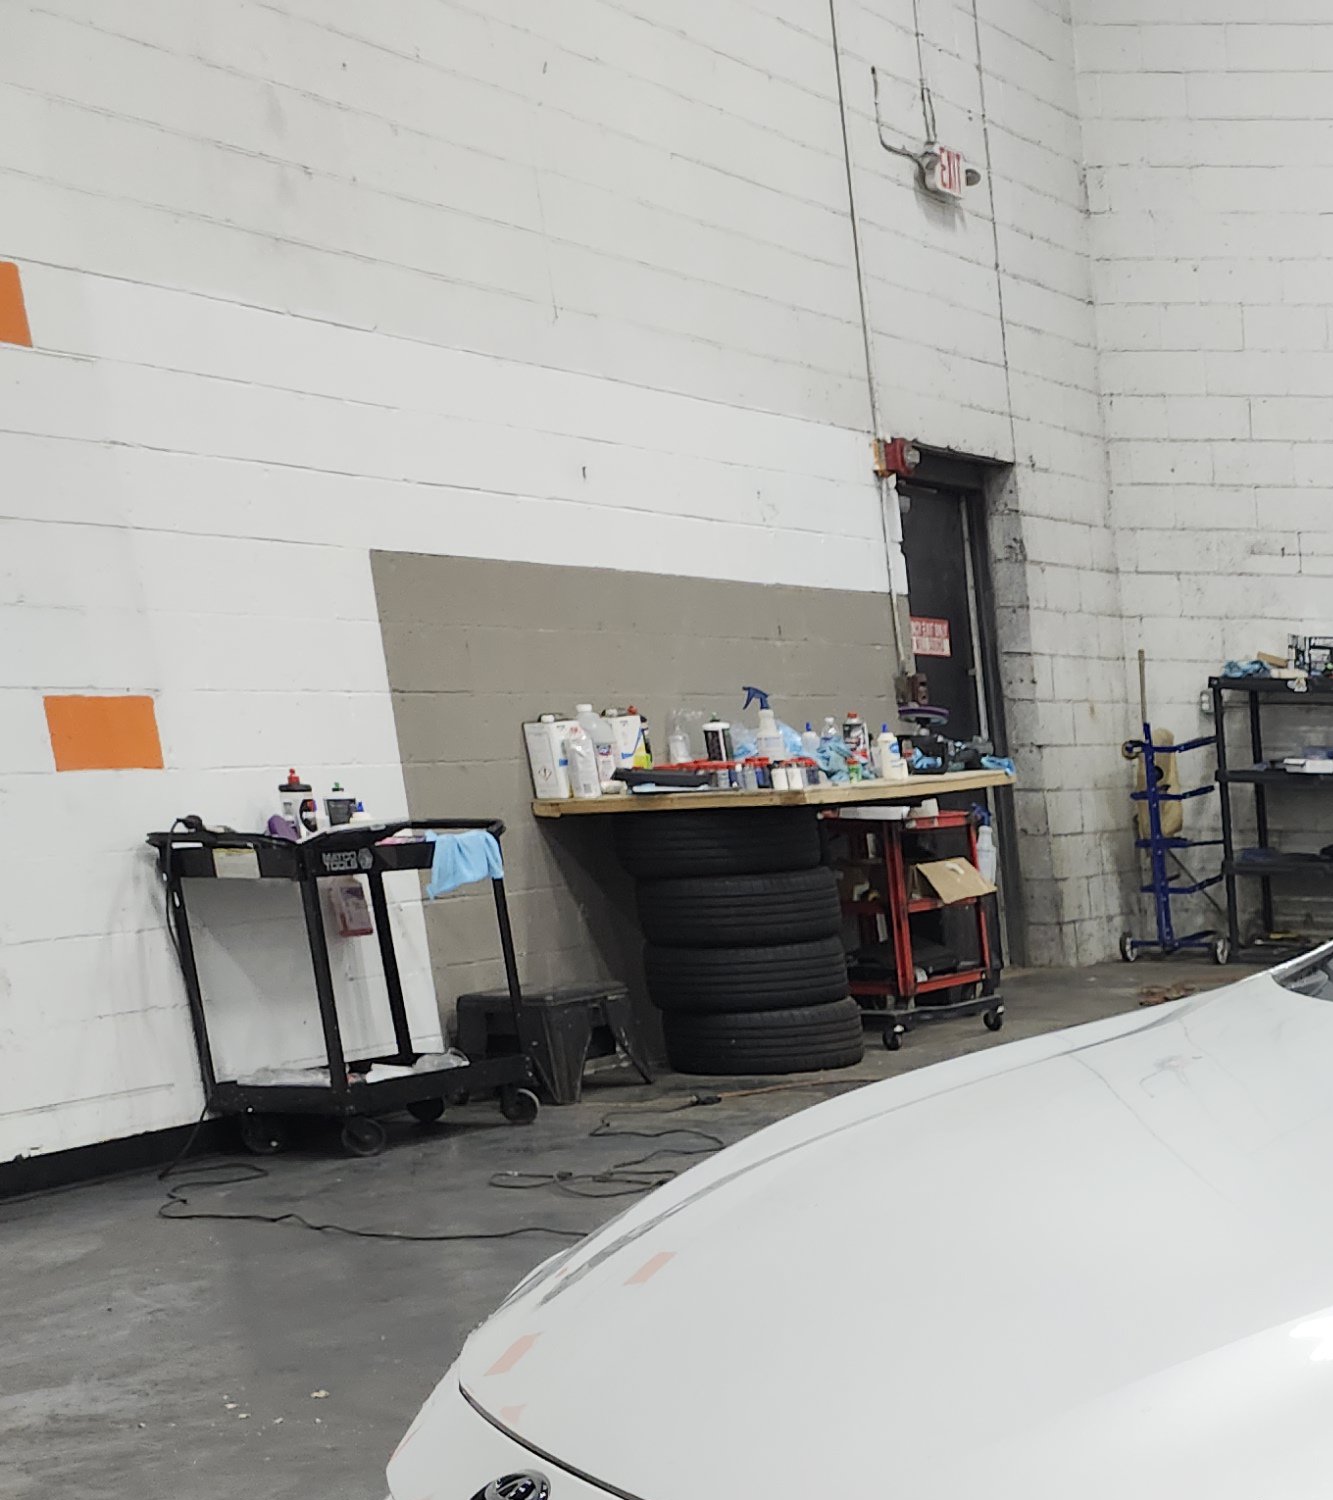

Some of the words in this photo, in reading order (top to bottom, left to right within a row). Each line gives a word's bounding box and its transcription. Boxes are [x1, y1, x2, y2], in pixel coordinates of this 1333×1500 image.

[939, 145, 962, 195] EXIT
[322, 851, 357, 863] MATCO
[325, 860, 358, 871] TOOLS
